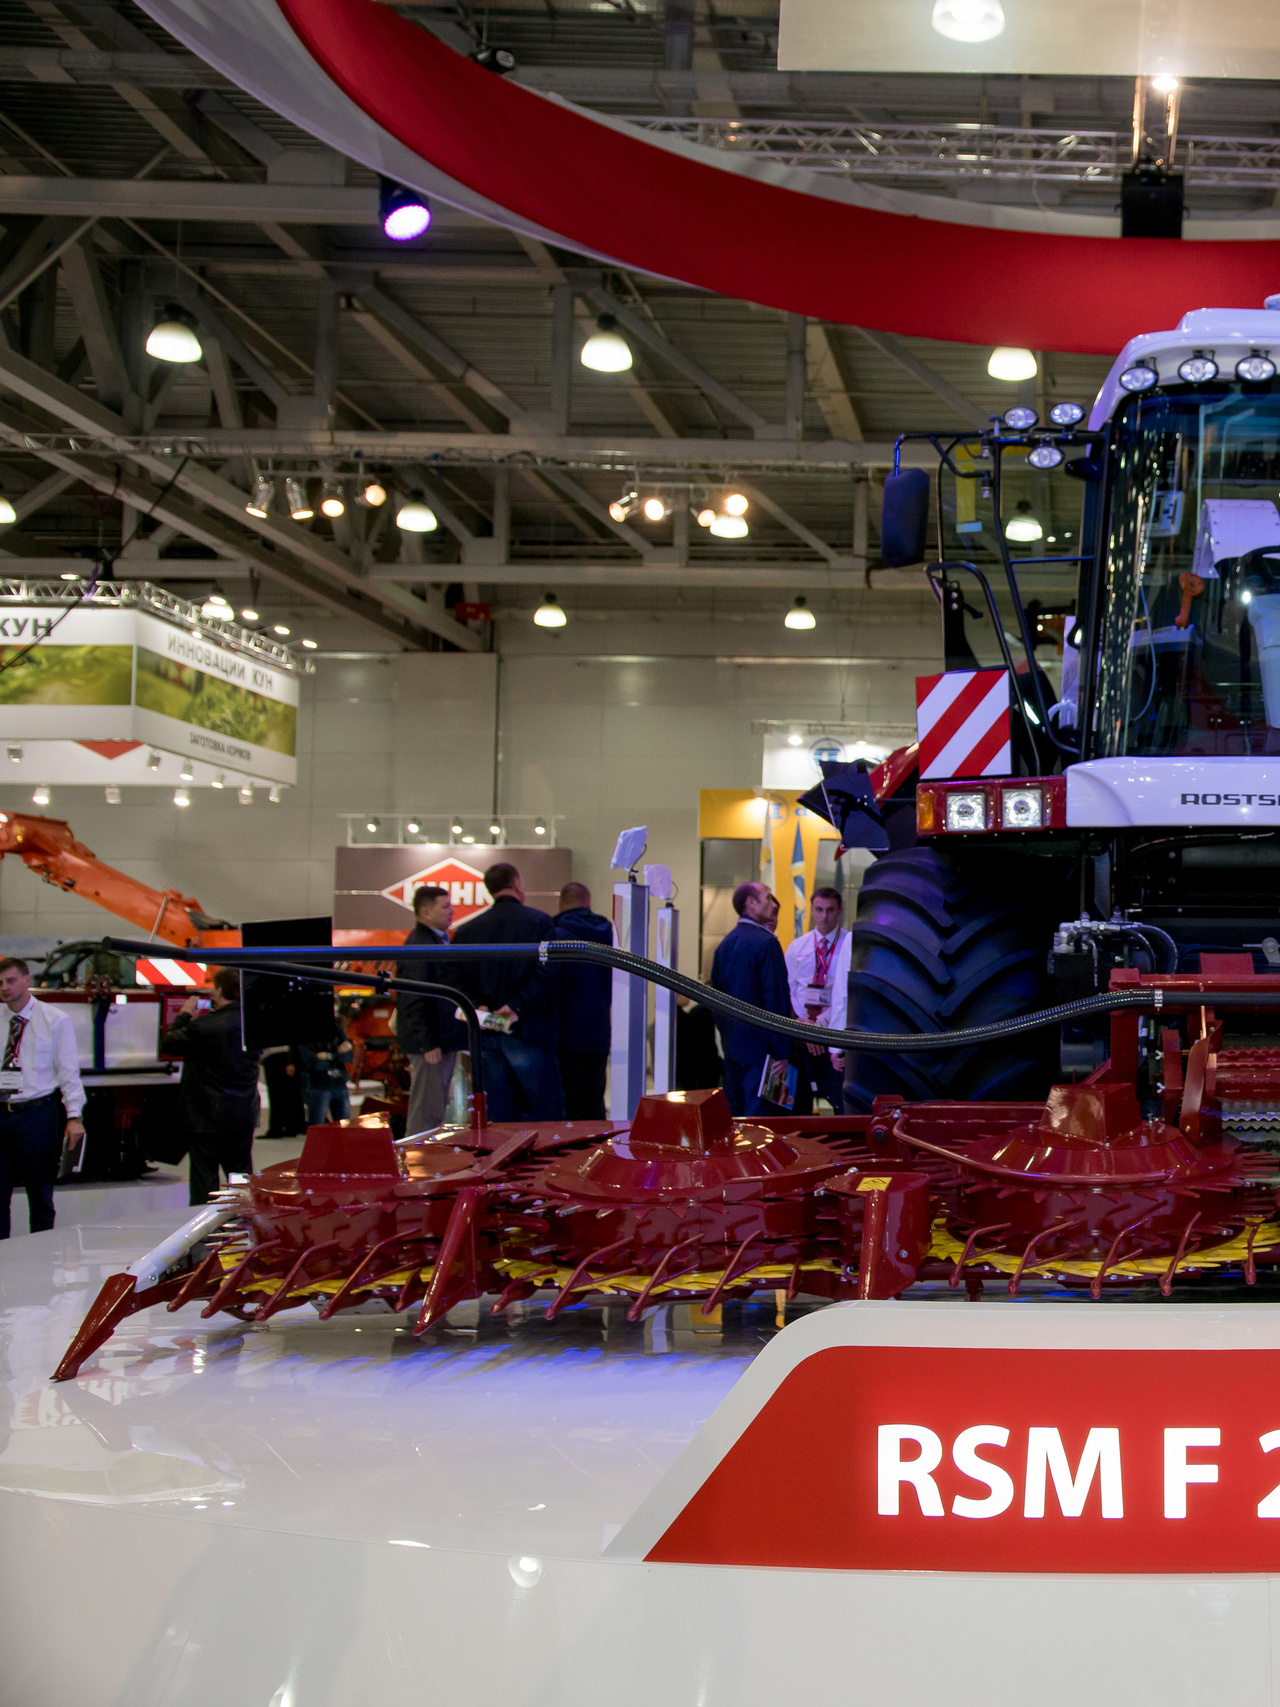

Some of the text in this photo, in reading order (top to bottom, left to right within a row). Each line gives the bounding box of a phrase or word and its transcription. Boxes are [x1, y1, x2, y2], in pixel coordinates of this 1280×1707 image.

[167, 632, 274, 691] ИННОВАЦИИ КУН
[189, 731, 226, 753] ЗАГОТОВКА
[877, 1423, 1124, 1519] RSM
[1163, 1427, 1221, 1519] F
